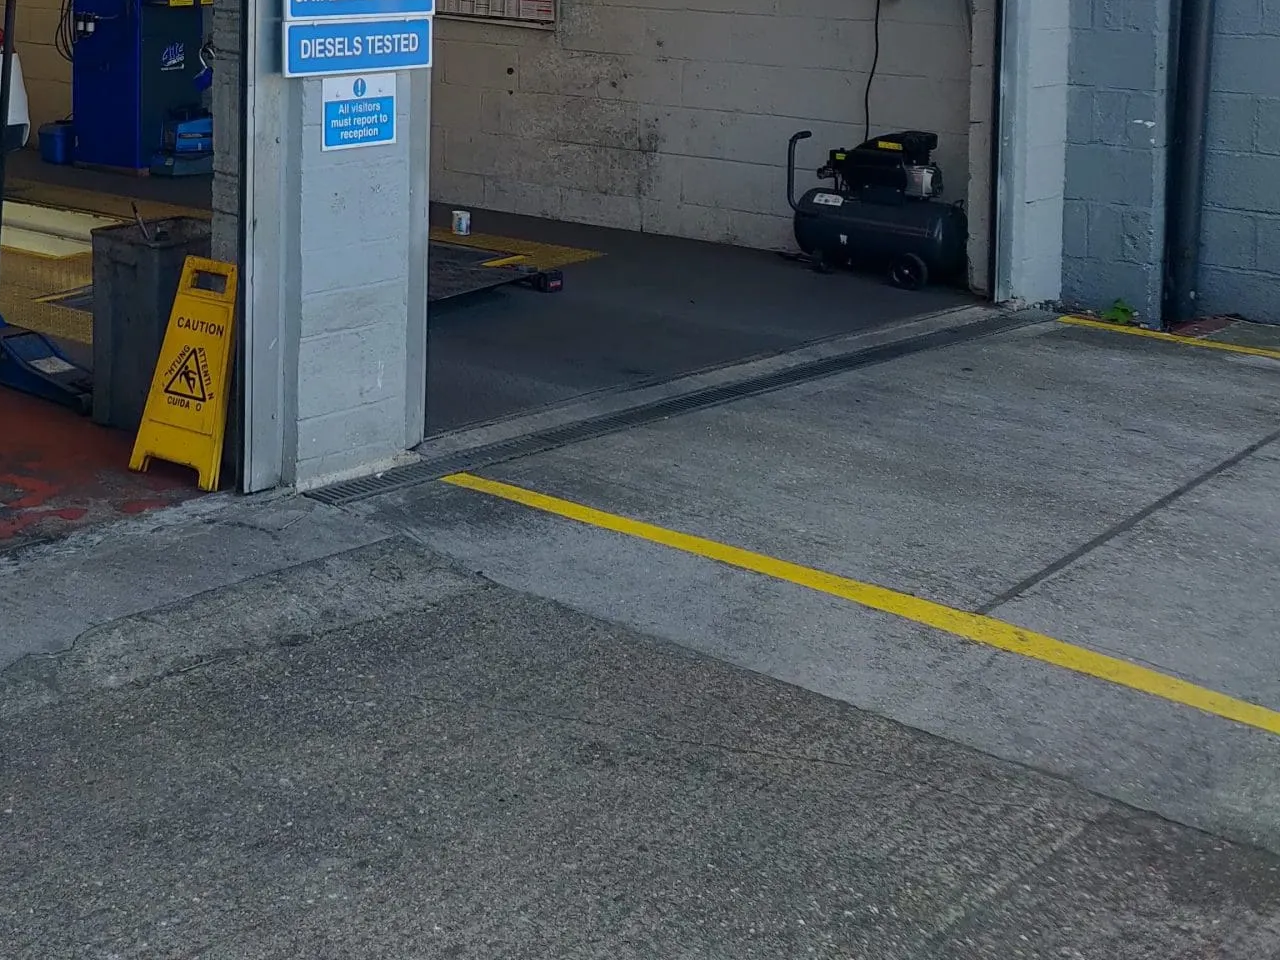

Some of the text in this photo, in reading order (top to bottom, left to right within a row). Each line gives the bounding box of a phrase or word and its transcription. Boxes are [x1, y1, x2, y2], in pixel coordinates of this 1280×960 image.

[301, 33, 418, 59] DIESELS TESTED
[338, 102, 380, 114] All visitors
[331, 114, 388, 128] must report to
[340, 127, 379, 140] reception
[177, 316, 224, 337] CAUTION
[198, 347, 214, 400] ATTENTIN
[167, 395, 202, 412] CUIDAO
